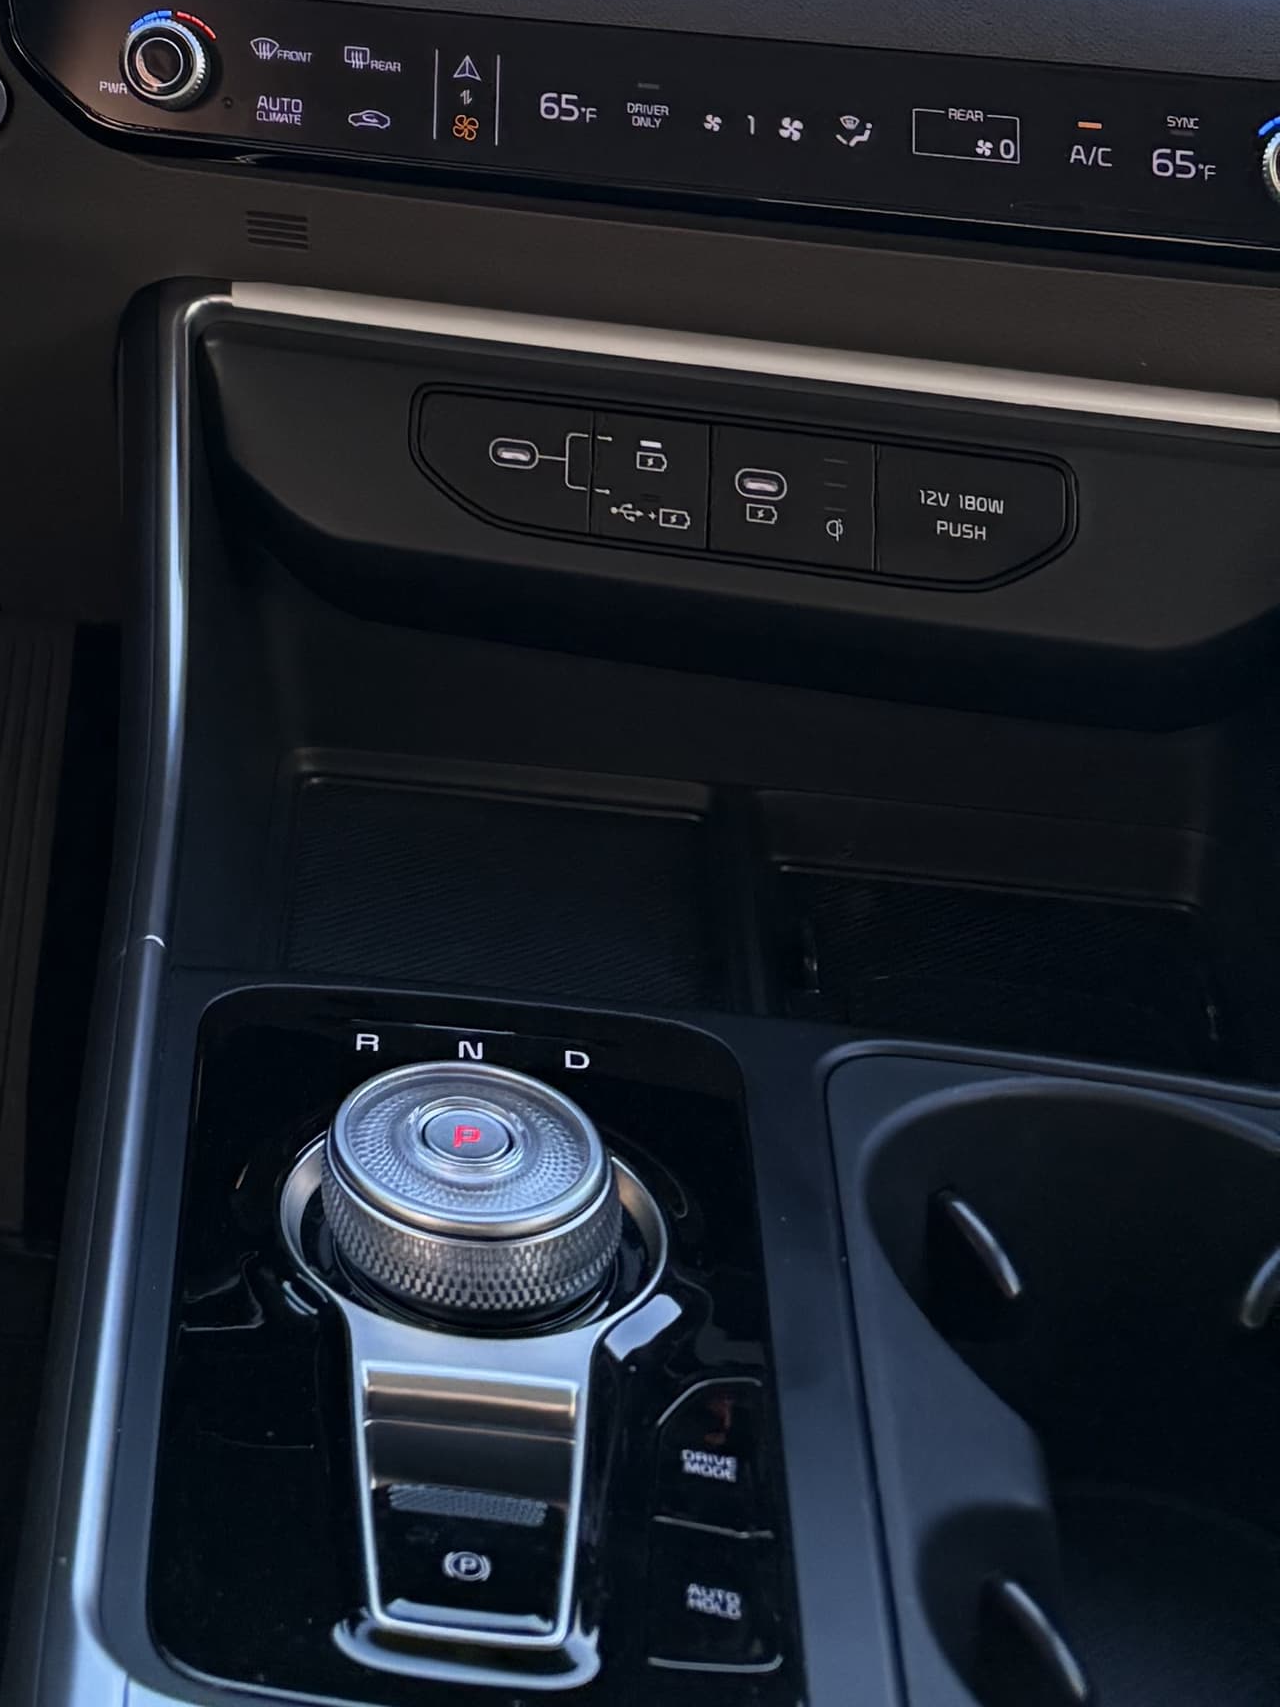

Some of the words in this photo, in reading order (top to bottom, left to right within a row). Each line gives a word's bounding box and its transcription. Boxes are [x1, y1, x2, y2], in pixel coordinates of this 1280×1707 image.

[275, 49, 314, 64] FRONT
[369, 58, 402, 74] REAR
[98, 80, 128, 95] PWR
[256, 95, 304, 114] AUTO
[626, 102, 670, 117] DRIVER
[947, 107, 984, 123] REAR
[255, 109, 303, 126] CLIMATE
[631, 115, 662, 130] ONLY
[746, 113, 757, 136] 1
[1165, 114, 1201, 130] SYNC
[998, 138, 1016, 161] 0
[1068, 144, 1114, 168] A/C
[918, 489, 951, 508] 12V
[958, 494, 1005, 515] 180W
[936, 519, 988, 542] PUSH
[354, 1032, 381, 1052] R
[457, 1040, 485, 1061] N
[563, 1049, 592, 1070] D
[451, 1125, 482, 1149] P
[680, 1448, 737, 1469] DRIVE
[682, 1461, 737, 1483] MODE
[687, 1582, 741, 1605] AUTO
[686, 1596, 742, 1621] HOLD
